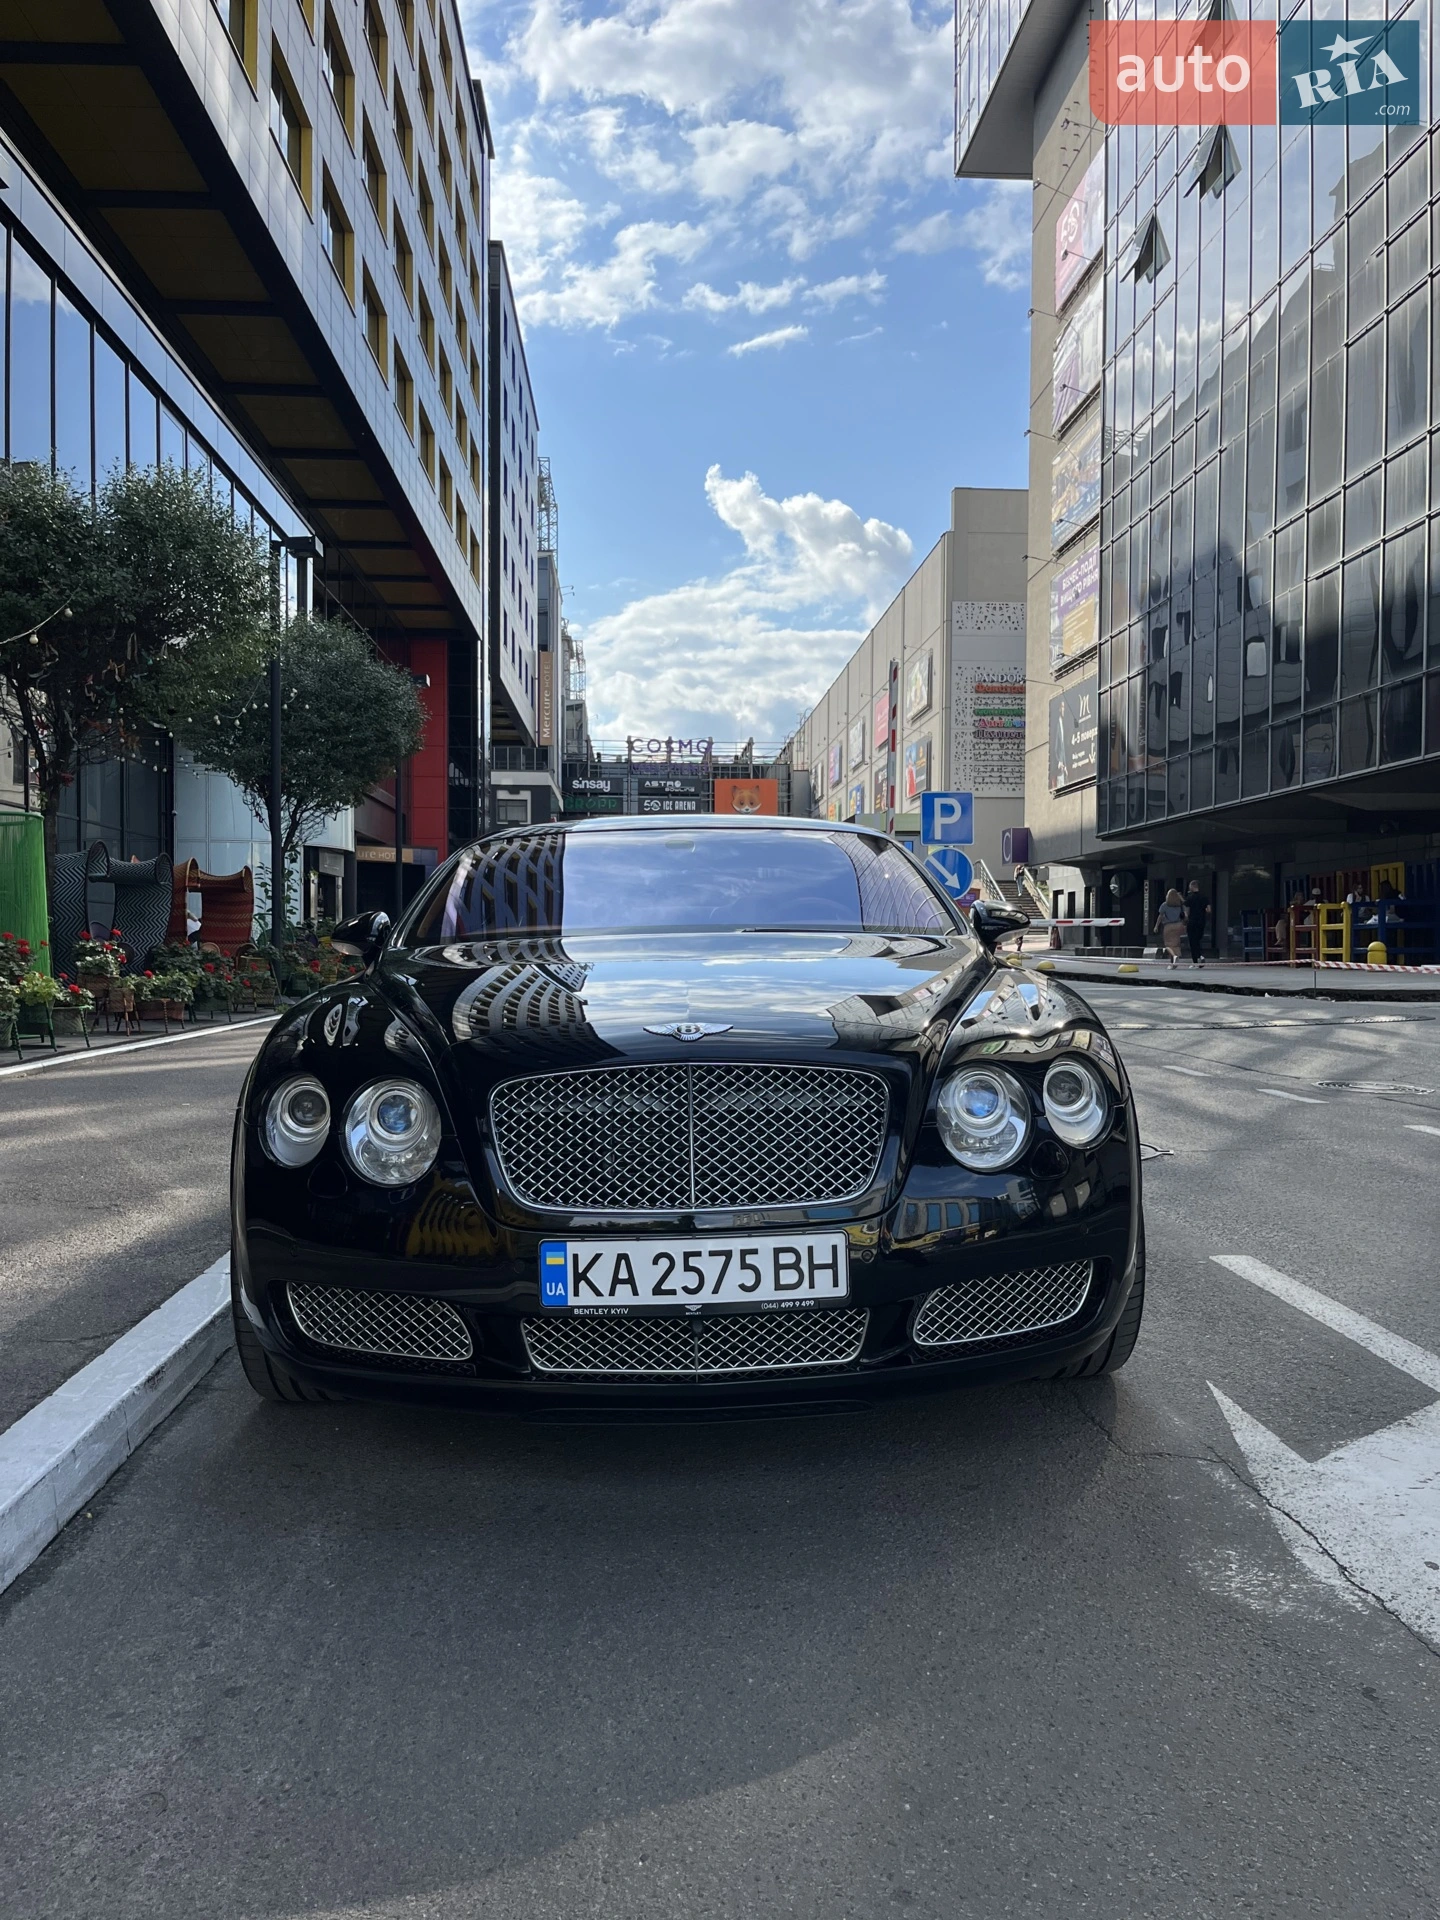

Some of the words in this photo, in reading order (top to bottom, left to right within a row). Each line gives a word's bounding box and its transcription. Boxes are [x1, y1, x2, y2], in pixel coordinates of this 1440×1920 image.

[543, 661, 551, 688] HOTEL
[975, 673, 1024, 682] PANDOR
[542, 689, 551, 738] Mercure
[572, 777, 611, 792] sinsay
[663, 800, 673, 811] ICE
[674, 800, 696, 811] ARENA
[934, 797, 962, 840] P
[572, 1252, 639, 1297] KA
[651, 1248, 761, 1296] 2575
[773, 1244, 839, 1291] BH
[546, 1282, 565, 1296] UA
[574, 1308, 608, 1316] BENTLEY
[610, 1307, 629, 1316] KYIV
[760, 1301, 779, 1310] (044)
[780, 1301, 793, 1309] 499
[801, 1300, 815, 1308] 499
